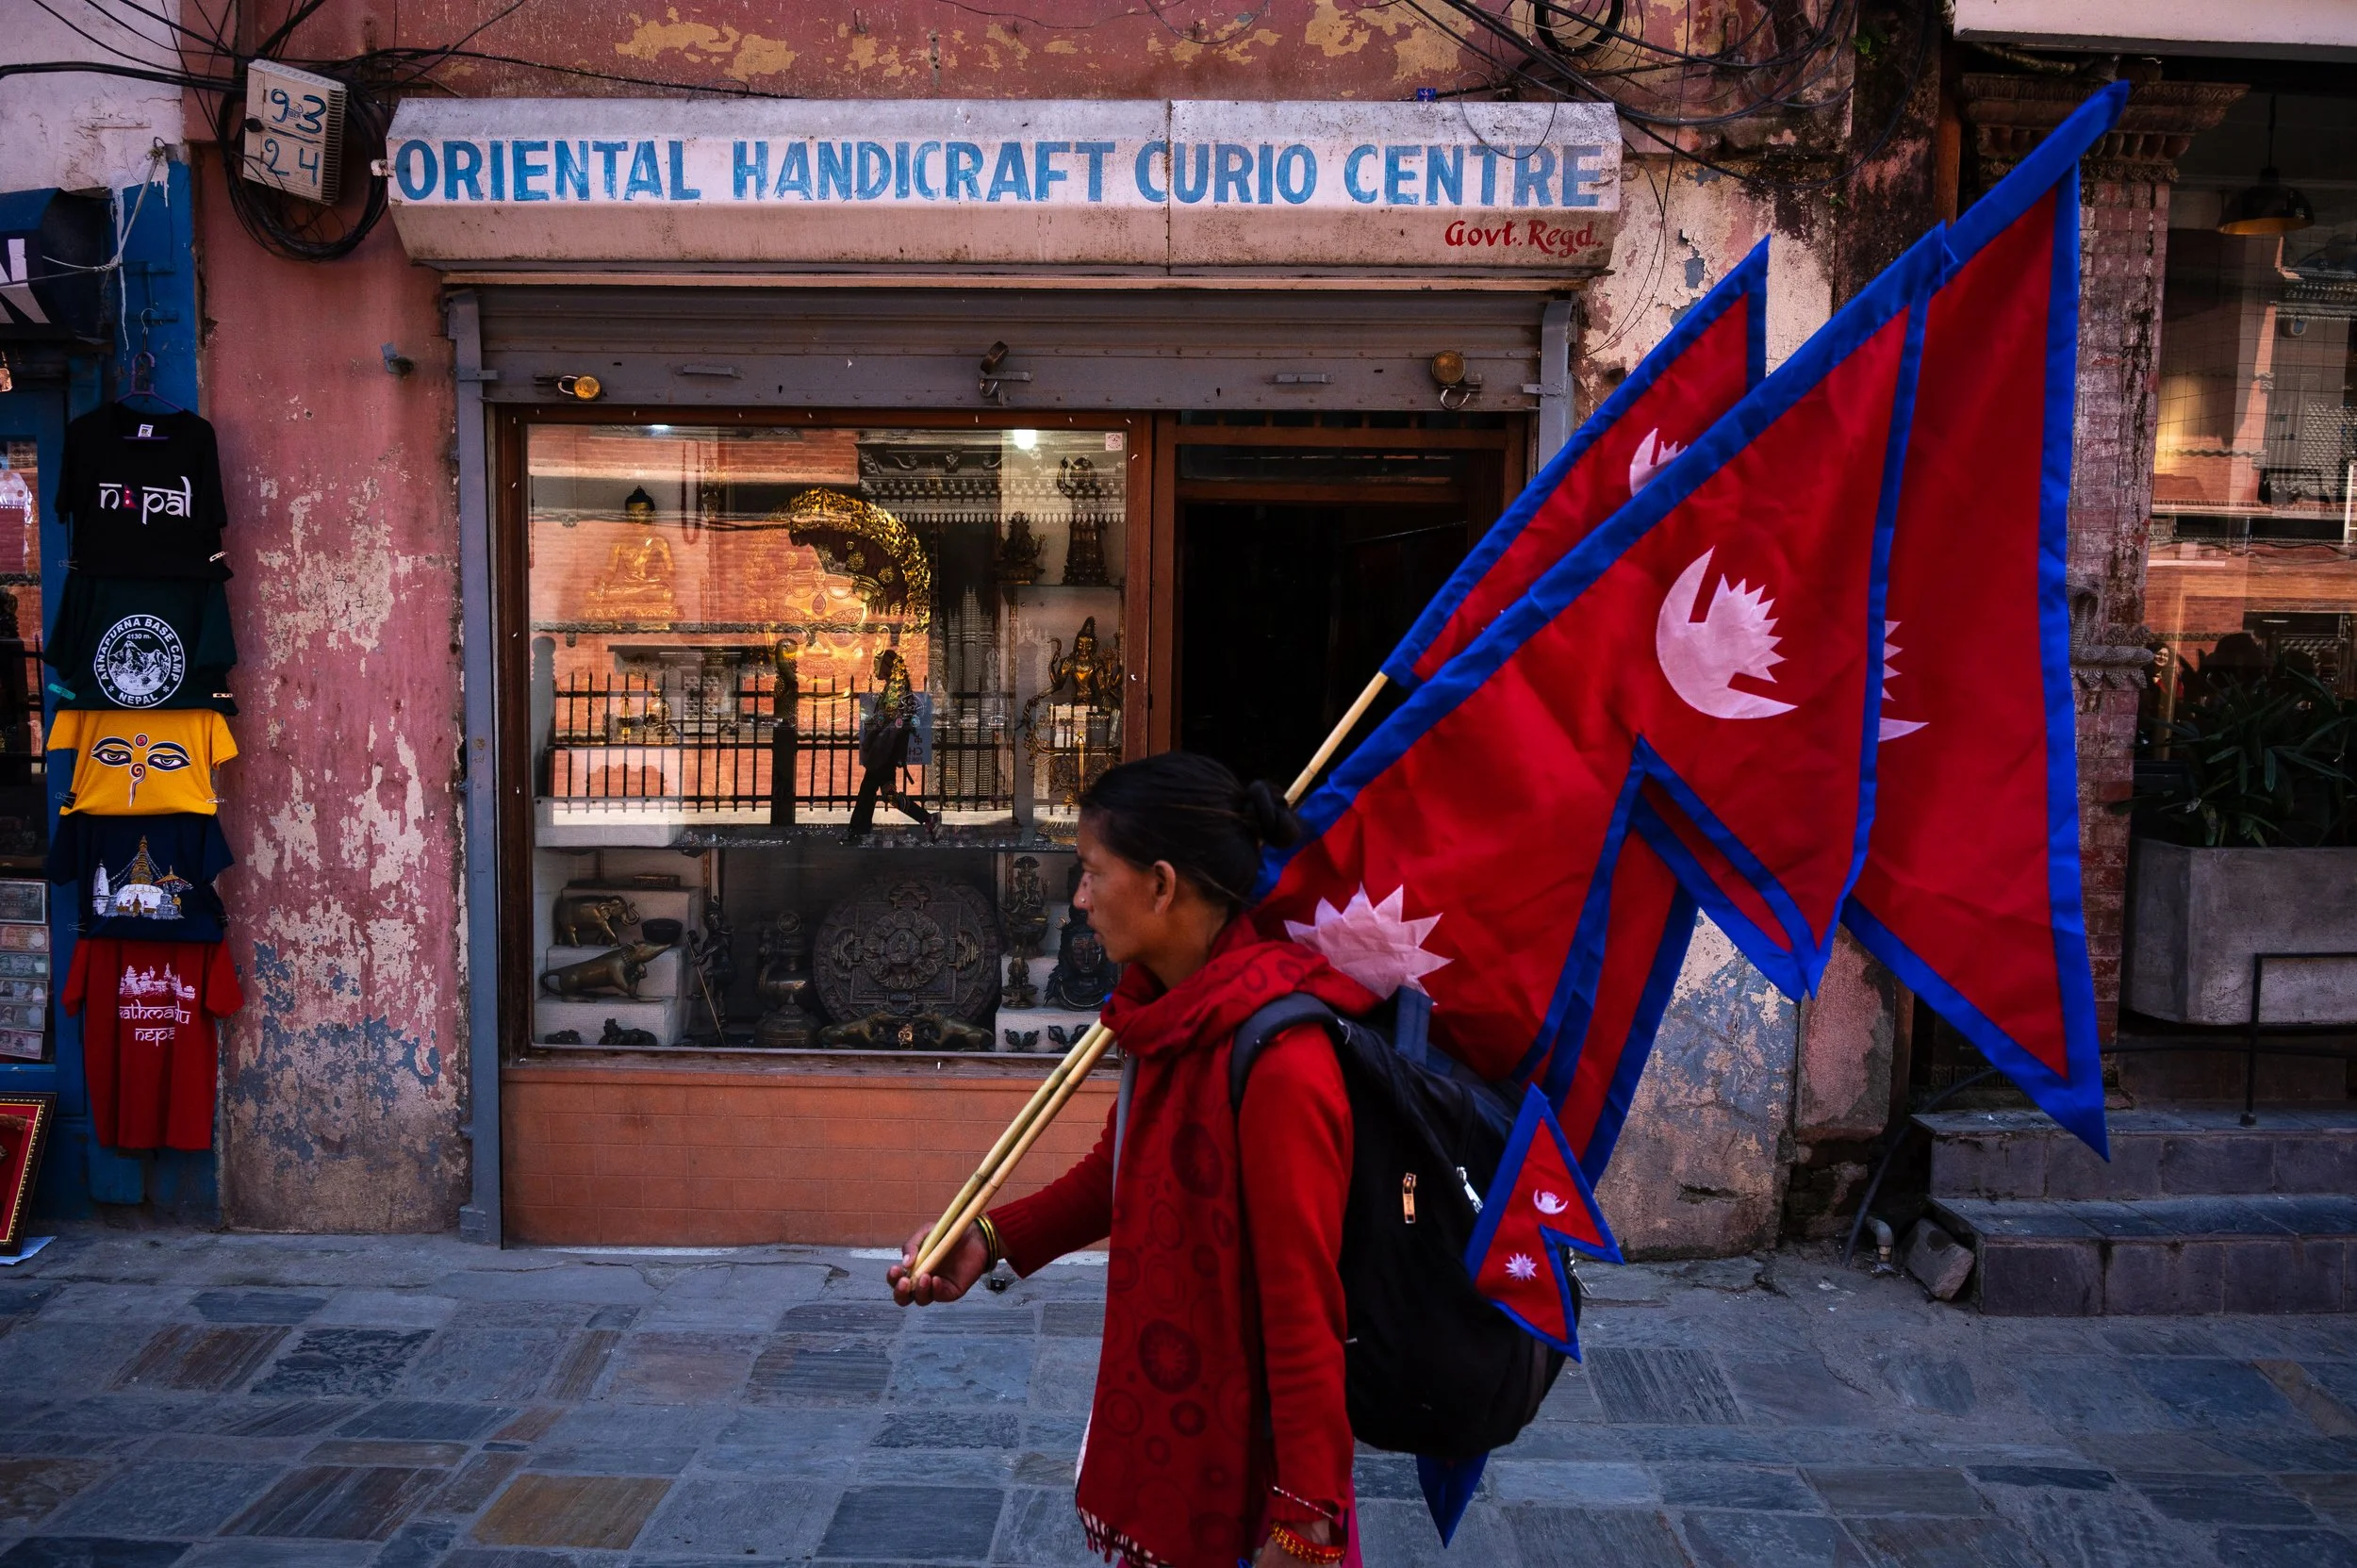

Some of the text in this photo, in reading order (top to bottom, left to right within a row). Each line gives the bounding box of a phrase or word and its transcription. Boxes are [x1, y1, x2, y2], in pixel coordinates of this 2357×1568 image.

[271, 89, 327, 134] 93
[264, 138, 320, 187] 24
[395, 139, 1604, 208] ORIENTAL HANDICRAFT CURIO CENTRE
[1444, 219, 1604, 258] Govt. Regd.
[96, 618, 182, 682] ANNAPURNA BASE CAMP
[118, 692, 158, 705] NEPAL
